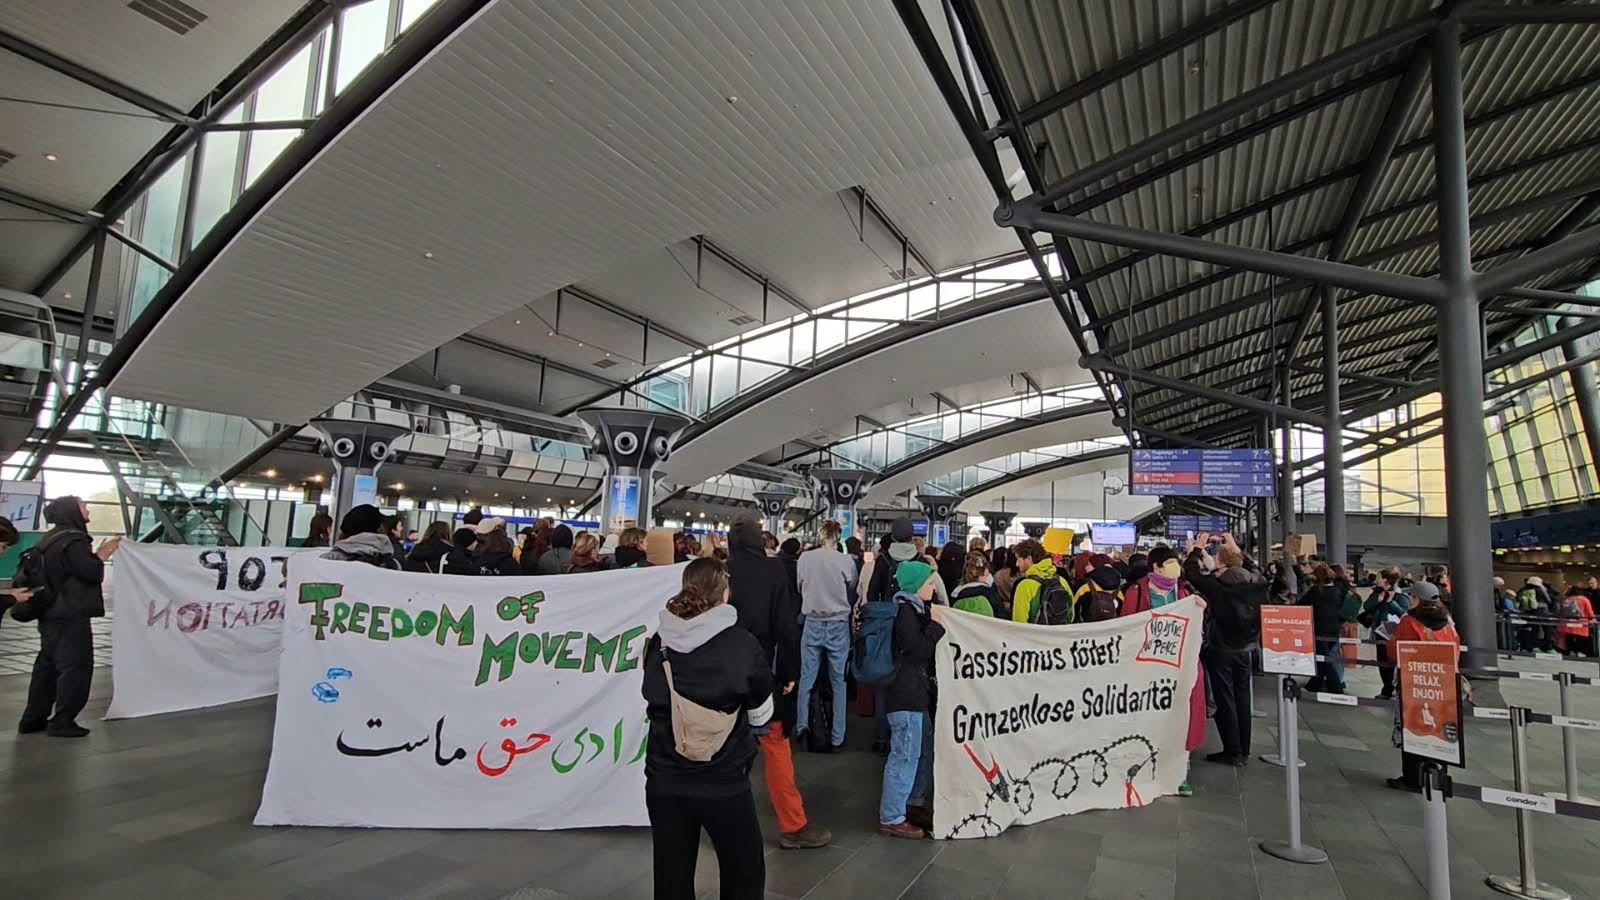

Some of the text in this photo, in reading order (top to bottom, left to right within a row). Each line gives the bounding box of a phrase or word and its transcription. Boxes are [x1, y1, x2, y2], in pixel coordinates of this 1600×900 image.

[298, 582, 545, 645] FREEDOM OF
[474, 625, 652, 687] MOVEME
[1408, 661, 1446, 674] STRETCH.
[1413, 675, 1441, 687] RELAX.
[1413, 687, 1444, 700] ENJOY!
[952, 693, 1074, 744] Grnzenlose
[476, 718, 551, 777] حق
[1505, 795, 1538, 807] condor
